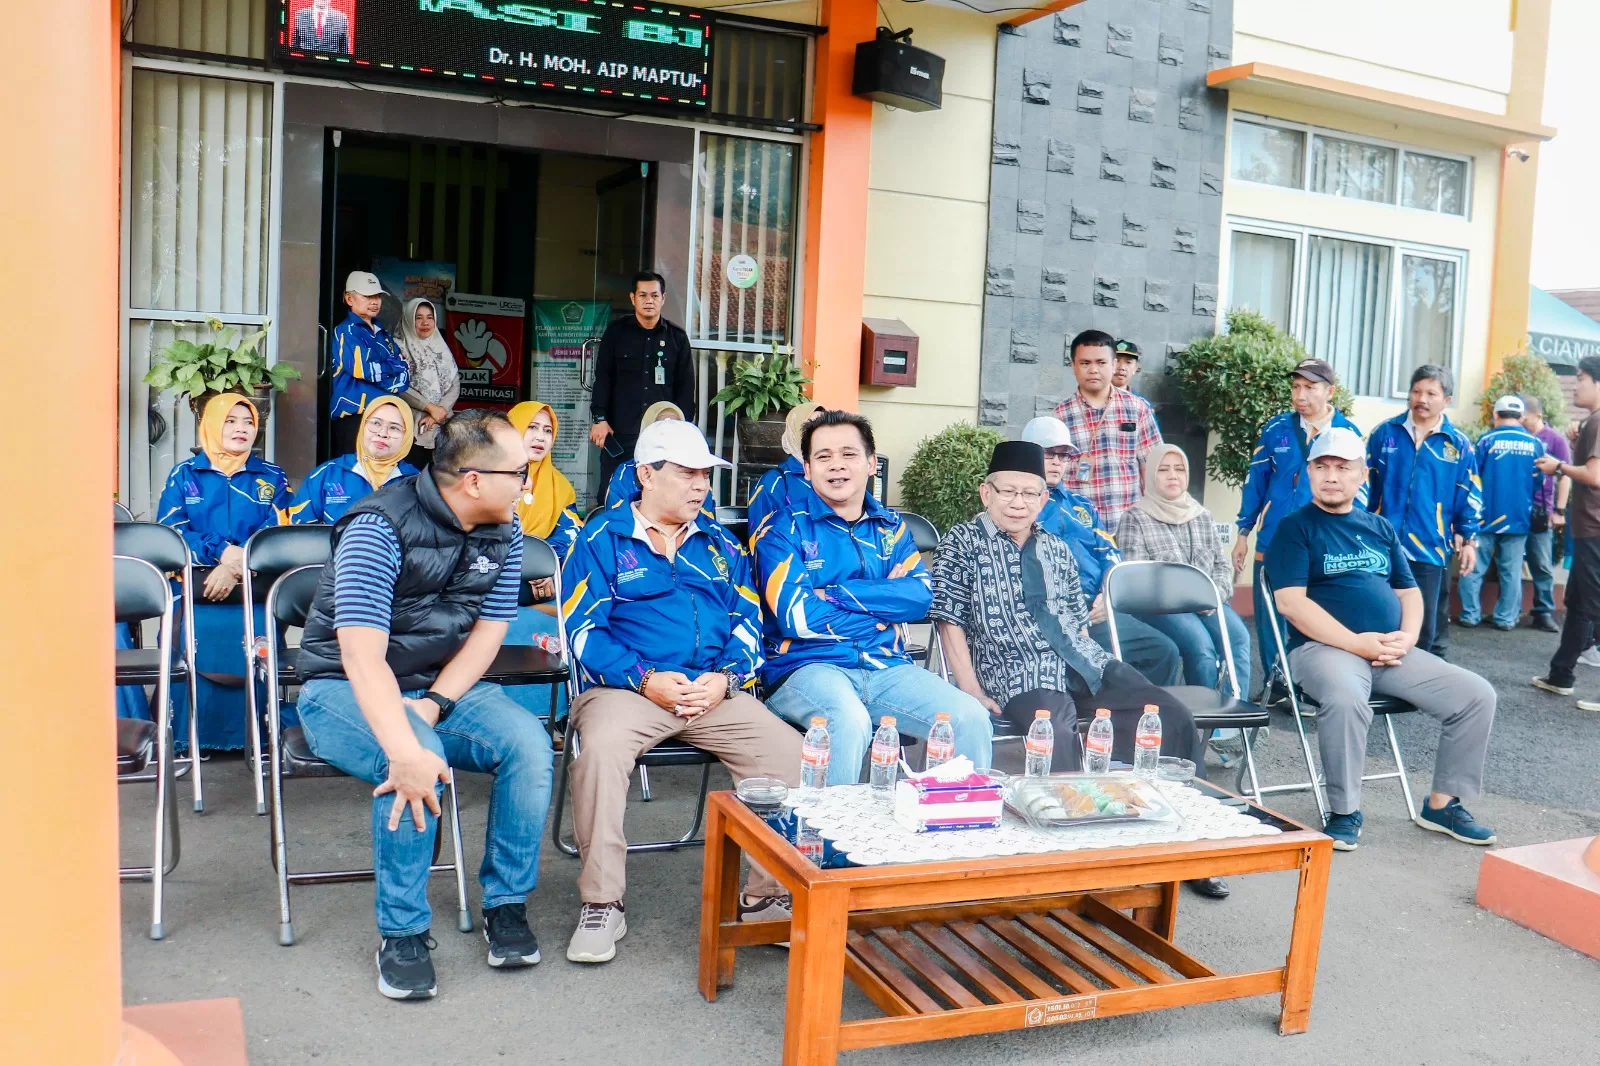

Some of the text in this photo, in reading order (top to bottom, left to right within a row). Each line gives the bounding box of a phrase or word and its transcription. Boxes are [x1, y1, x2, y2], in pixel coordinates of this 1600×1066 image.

[489, 47, 513, 65] Dr.
[519, 51, 538, 68] H.
[543, 54, 591, 75] MOH.
[597, 61, 628, 78] AIP
[458, 372, 487, 381] OLAK
[461, 387, 514, 398] RATIFIKASI
[1323, 553, 1360, 562] Majelis
[1326, 560, 1369, 570] NGOPI
